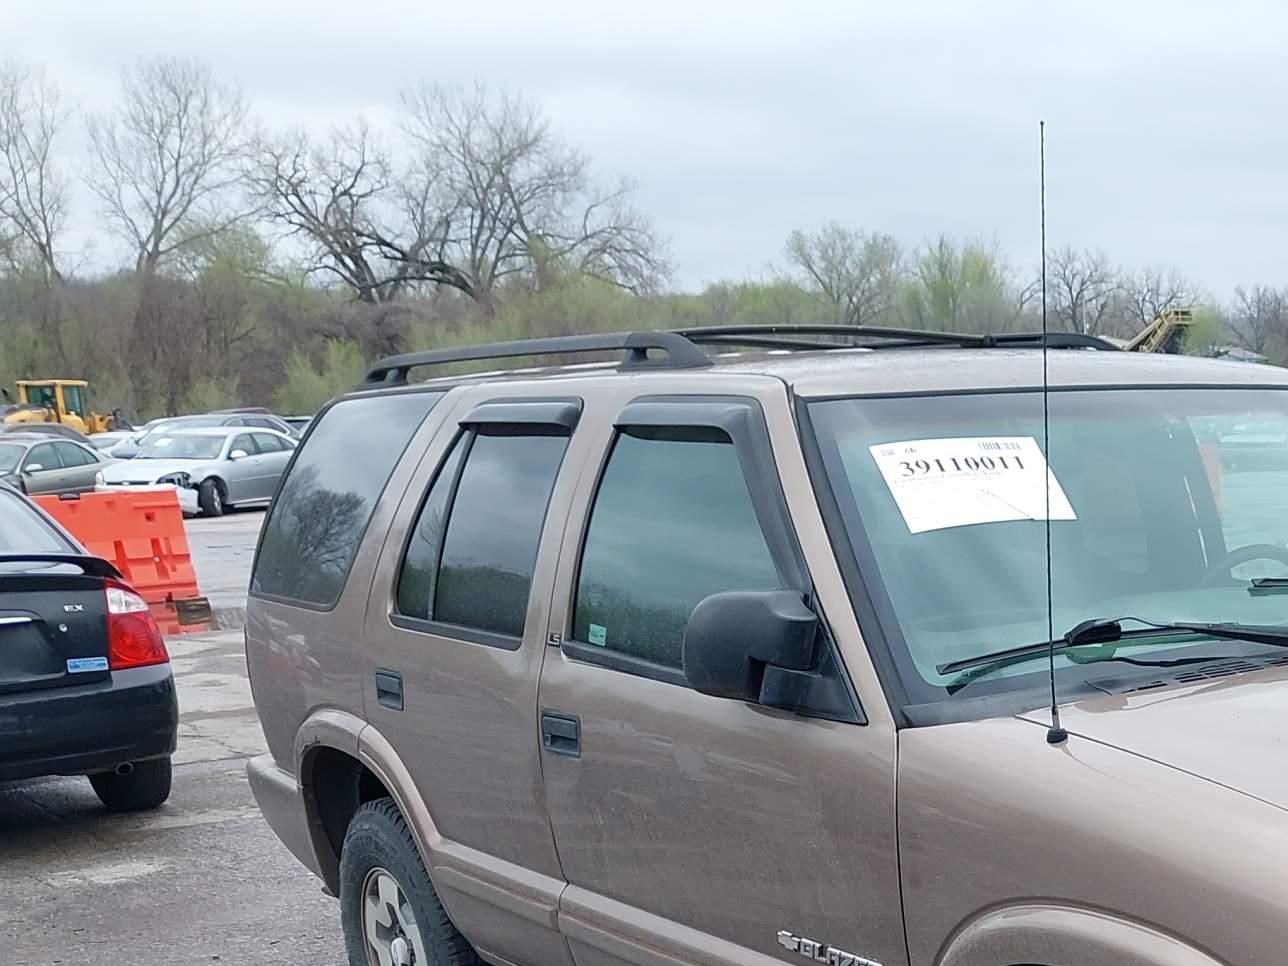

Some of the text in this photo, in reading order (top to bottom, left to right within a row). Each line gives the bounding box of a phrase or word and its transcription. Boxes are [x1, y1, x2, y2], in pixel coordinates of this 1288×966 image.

[899, 455, 1025, 478] 39110011
[63, 603, 85, 612] EX
[547, 633, 561, 647] LS
